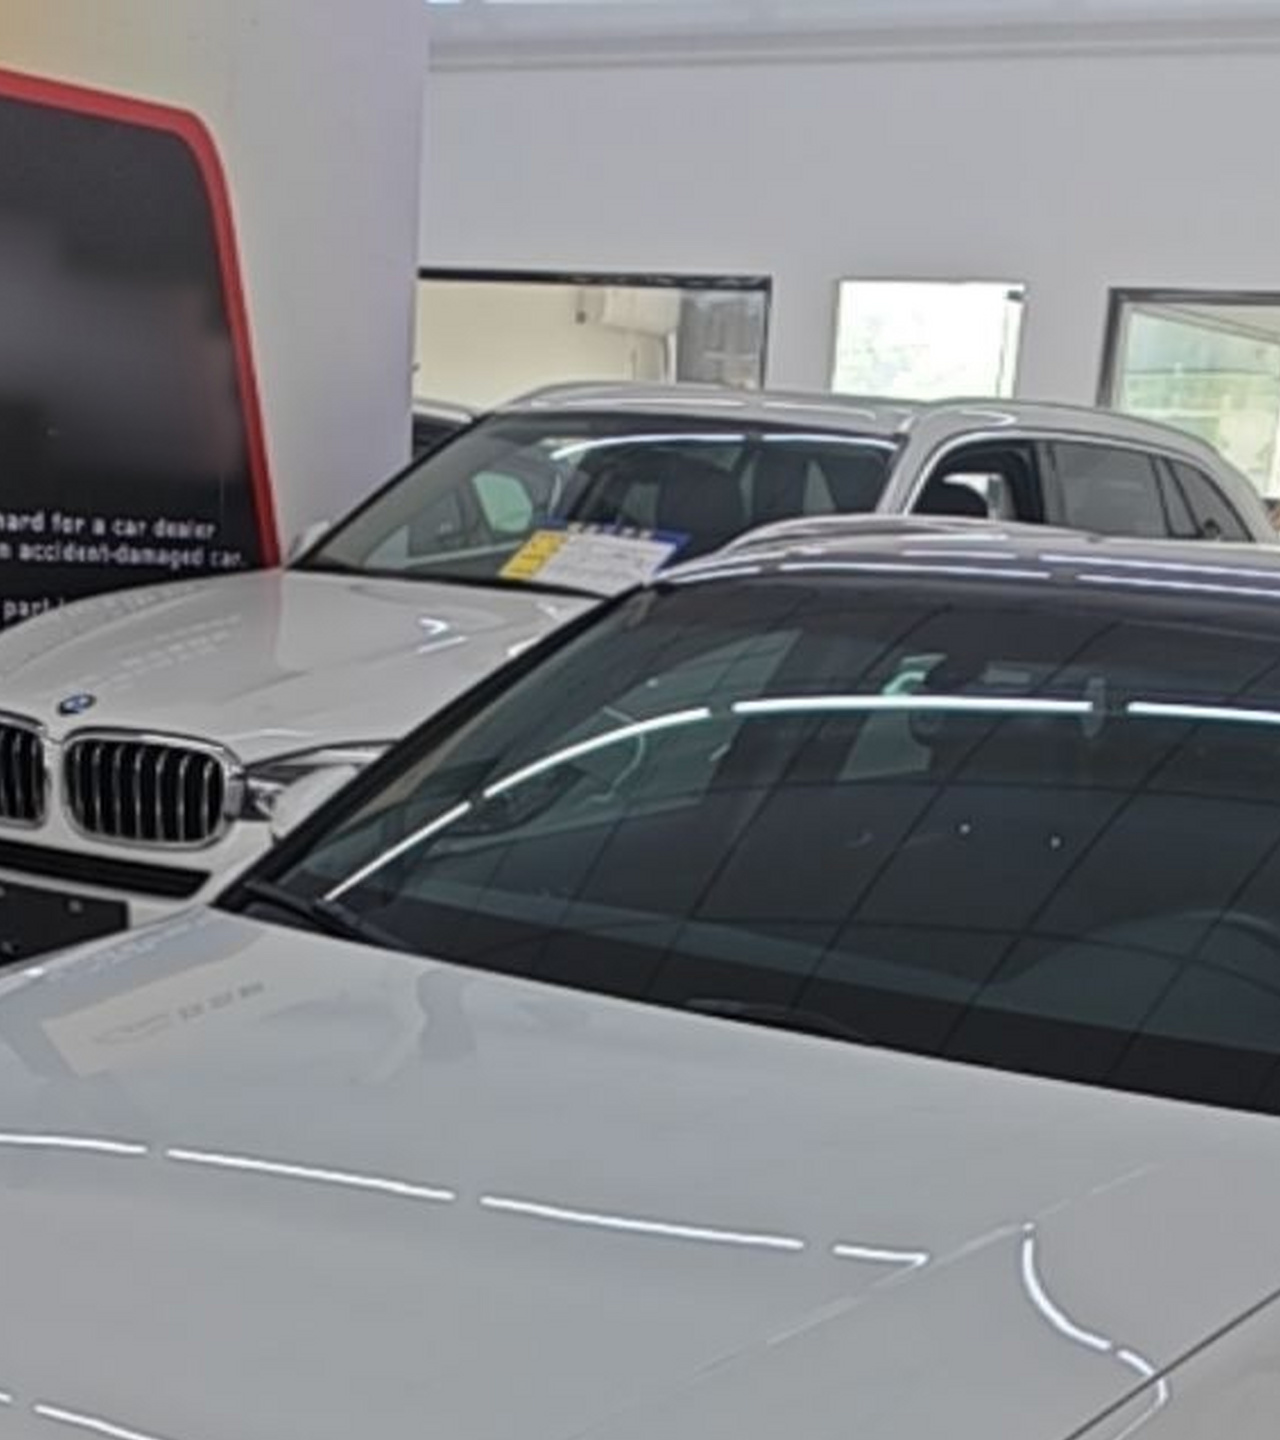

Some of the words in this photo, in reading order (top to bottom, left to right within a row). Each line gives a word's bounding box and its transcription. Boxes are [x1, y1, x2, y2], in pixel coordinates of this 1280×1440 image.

[51, 511, 85, 534] for
[92, 517, 107, 535] a
[112, 518, 147, 537] car
[151, 518, 216, 539] dealer
